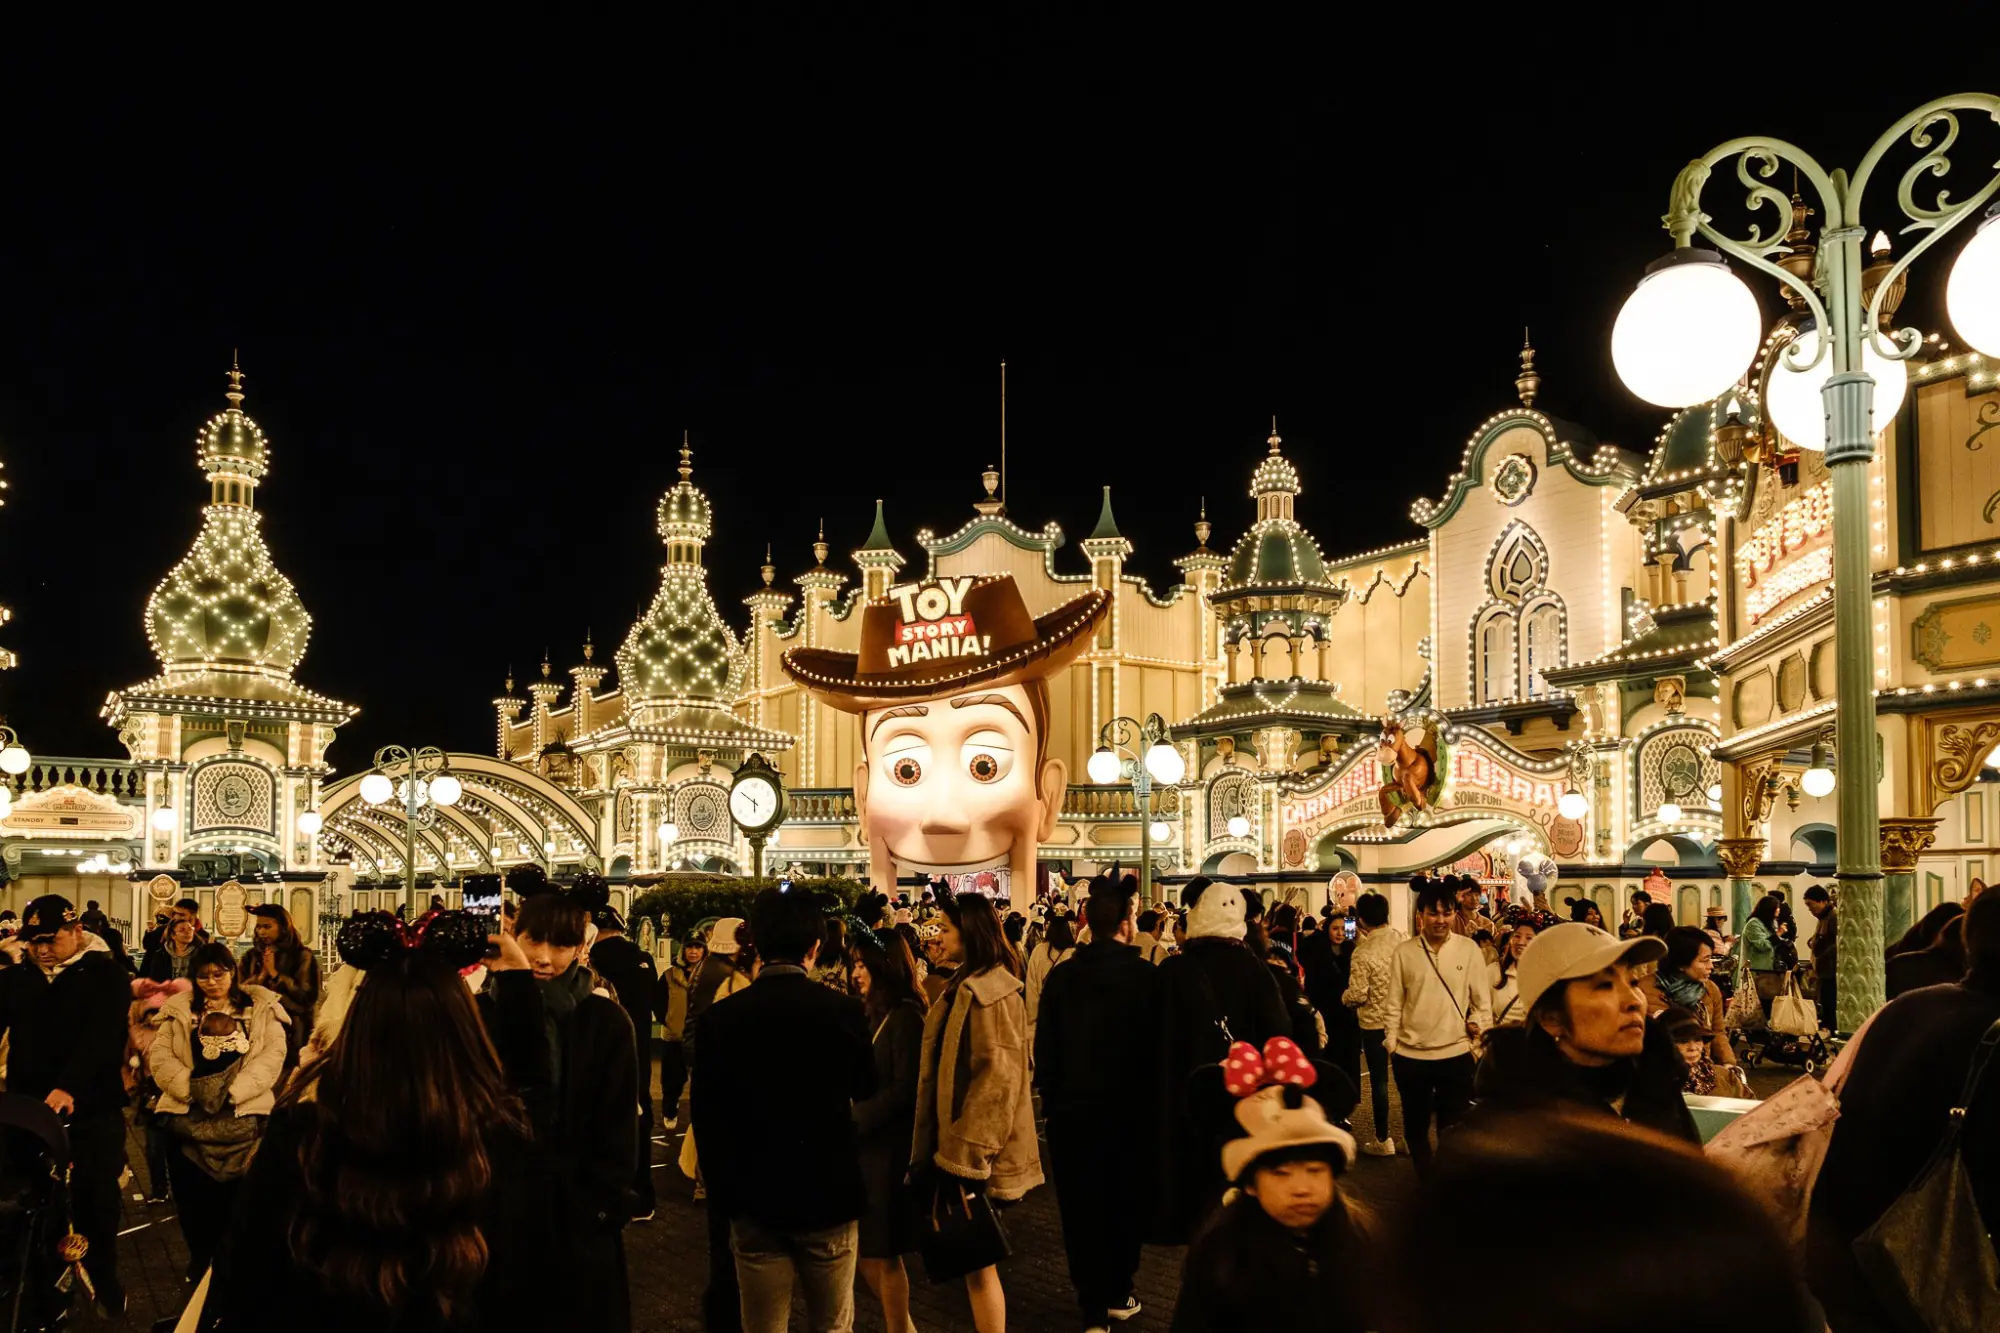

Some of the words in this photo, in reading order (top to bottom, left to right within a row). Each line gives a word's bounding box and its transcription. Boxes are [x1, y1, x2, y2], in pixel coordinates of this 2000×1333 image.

[888, 577, 975, 624] TOY
[901, 619, 968, 642] STORY
[887, 635, 992, 669] MANIA!
[1282, 759, 1382, 824] CARNIVAL
[1343, 797, 1374, 815] RUSTLE
[1454, 790, 1480, 806] SOME
[1481, 795, 1503, 806] FUN!
